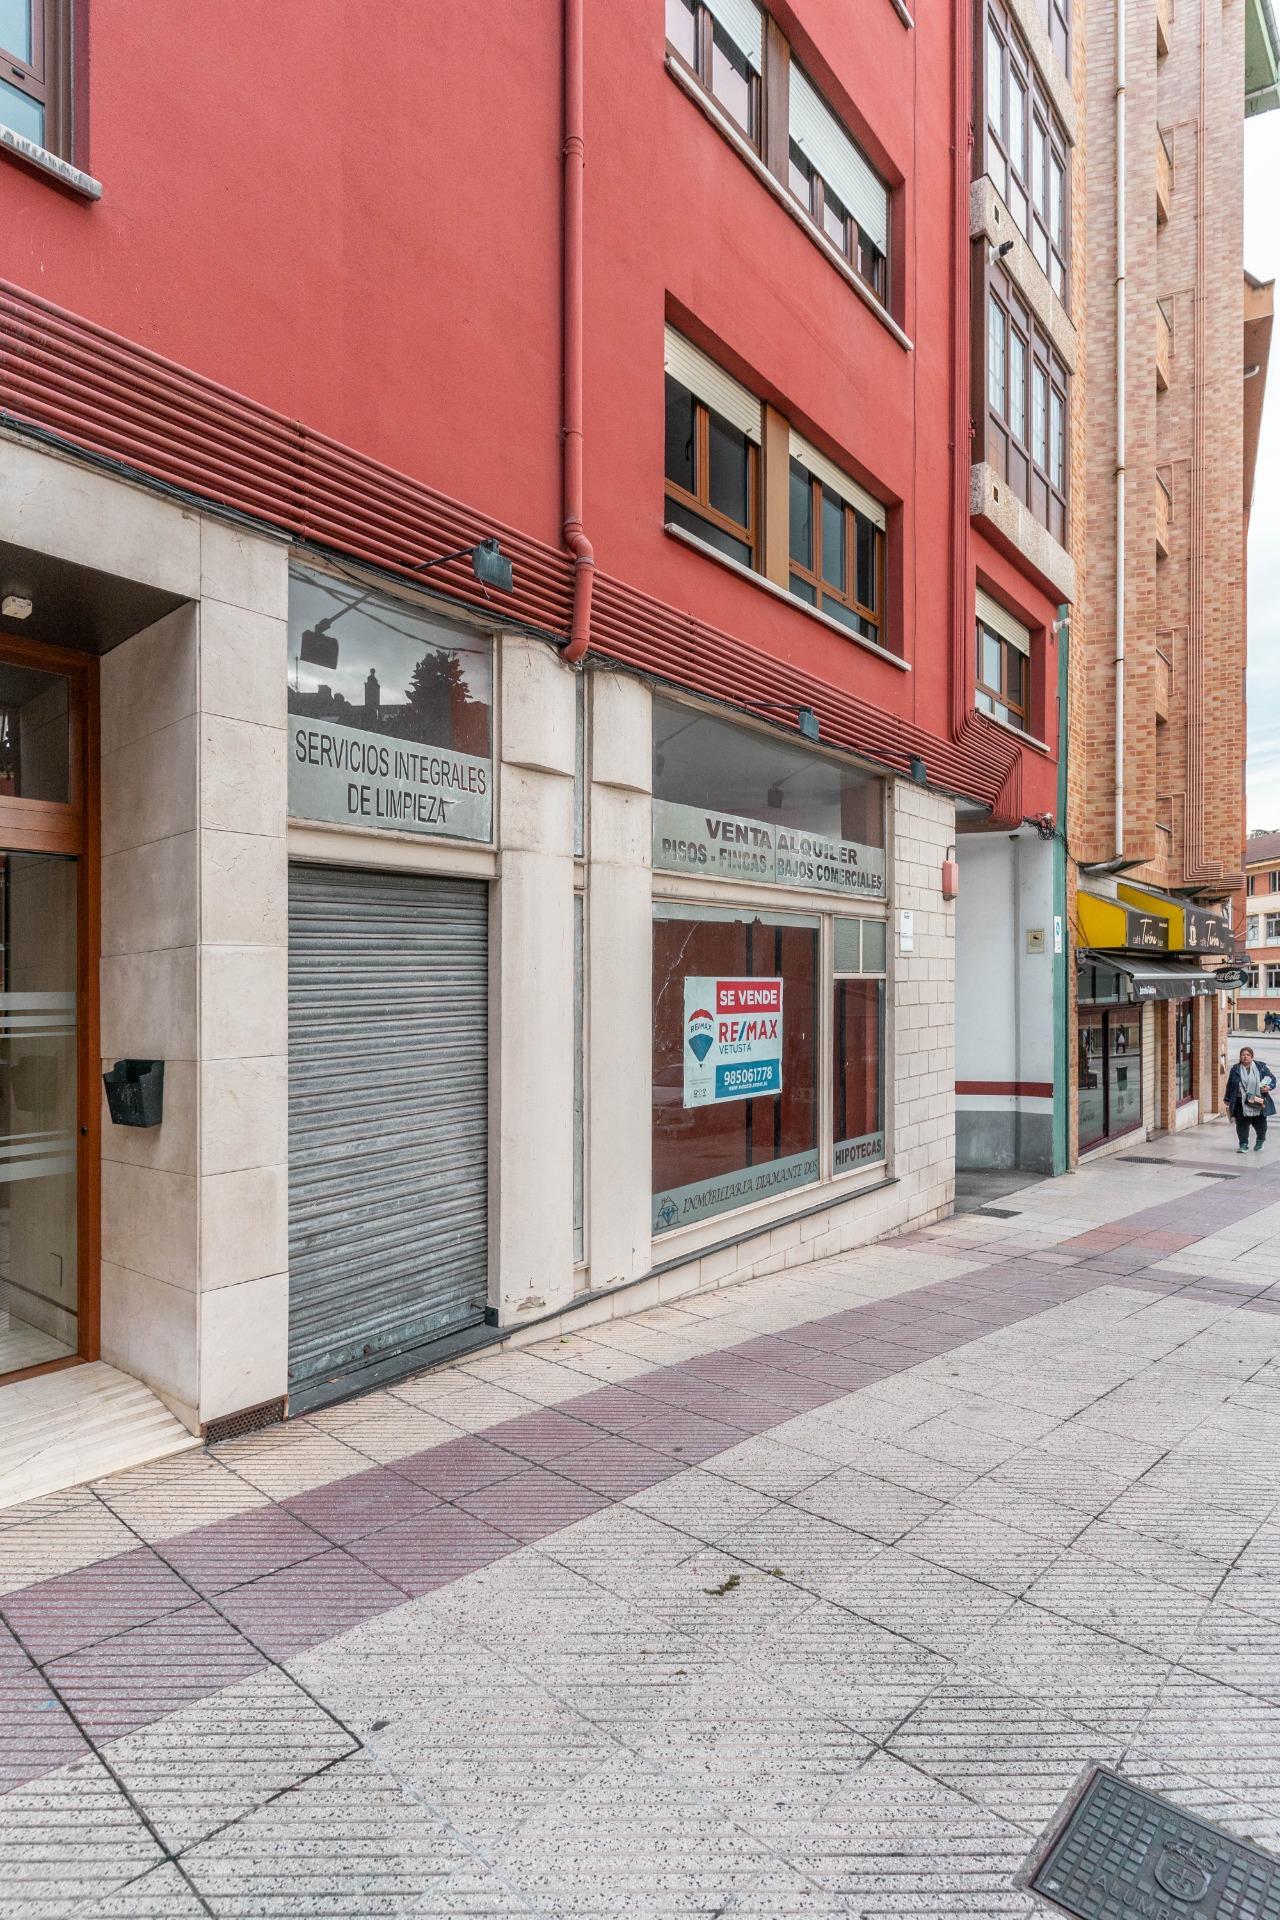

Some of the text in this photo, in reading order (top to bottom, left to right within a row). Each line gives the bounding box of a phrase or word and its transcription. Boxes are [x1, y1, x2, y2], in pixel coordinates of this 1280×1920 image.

[295, 729, 487, 795] SERVICIOS INTEGRALES
[347, 783, 447, 824] DE LIMPIEZA
[705, 818, 858, 865] VENTA ALQUILER
[662, 838, 708, 865] PISOS
[719, 848, 767, 873] FINCAS
[777, 857, 814, 880] BAJOS
[816, 864, 883, 890] COMERCIALES
[720, 989, 778, 1006] SE VENDE
[690, 1022, 712, 1033] RE/MAX
[718, 1019, 778, 1043] RE/MAX
[719, 1043, 752, 1055] VETUSTA
[724, 1066, 773, 1086] 985061778
[835, 1139, 882, 1166] HIPOTECAS
[683, 1159, 818, 1213] INMOBILIARIA DIAMANTE DOS
